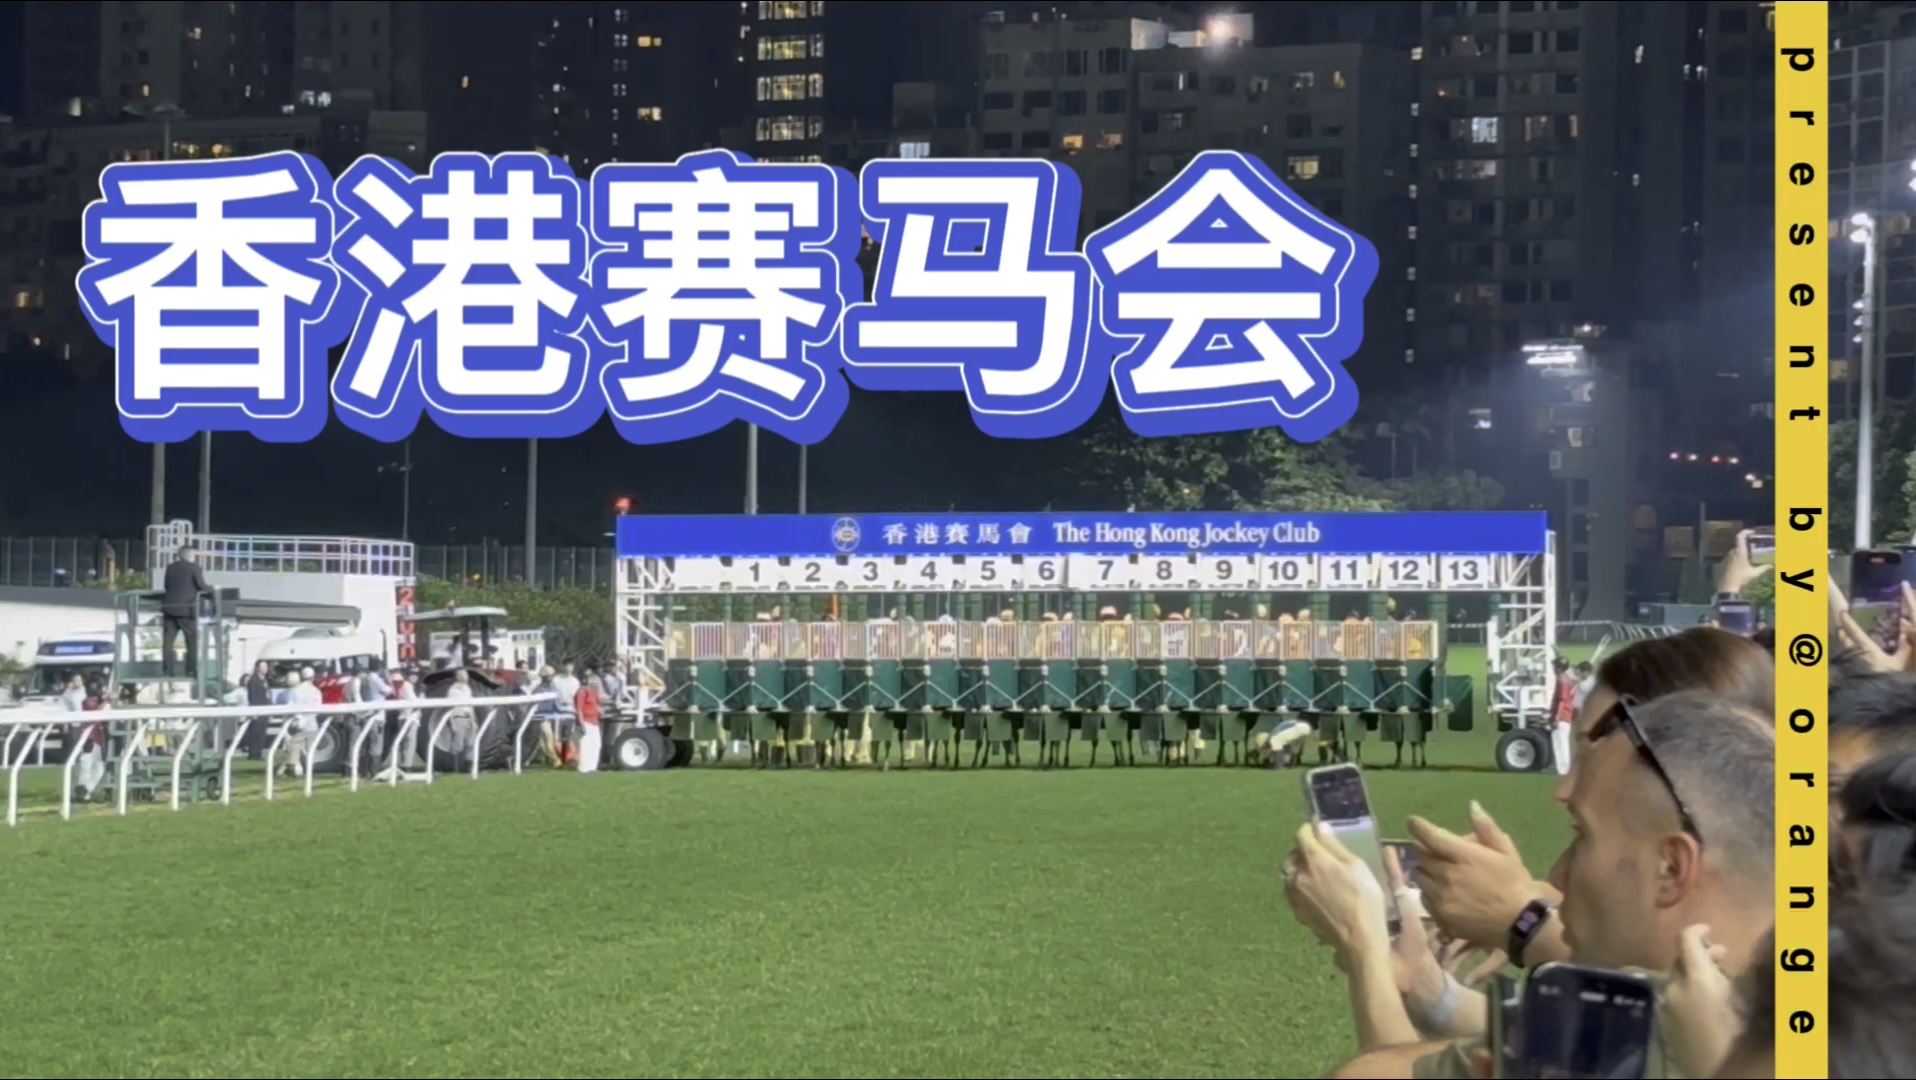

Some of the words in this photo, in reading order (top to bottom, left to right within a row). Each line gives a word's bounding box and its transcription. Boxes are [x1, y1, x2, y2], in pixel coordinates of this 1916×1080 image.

[882, 522, 1034, 545] 香港賽馬會
[1053, 521, 1091, 543] The
[1095, 522, 1147, 548] Hong
[1150, 522, 1200, 548] Kong
[1201, 521, 1270, 548] Jockey
[1272, 521, 1321, 543] Club
[749, 562, 760, 582] 1
[804, 561, 821, 582] 2
[862, 561, 879, 581] 3
[920, 561, 938, 581] 4
[979, 561, 997, 581] 5
[1037, 561, 1055, 581] 6
[1097, 561, 1114, 581] 7
[1156, 561, 1173, 581] 8
[1215, 561, 1233, 581] 9
[1268, 561, 1299, 581] 10
[1330, 560, 1358, 581] 11
[1388, 560, 1419, 581] 12
[1448, 560, 1479, 581] 13
